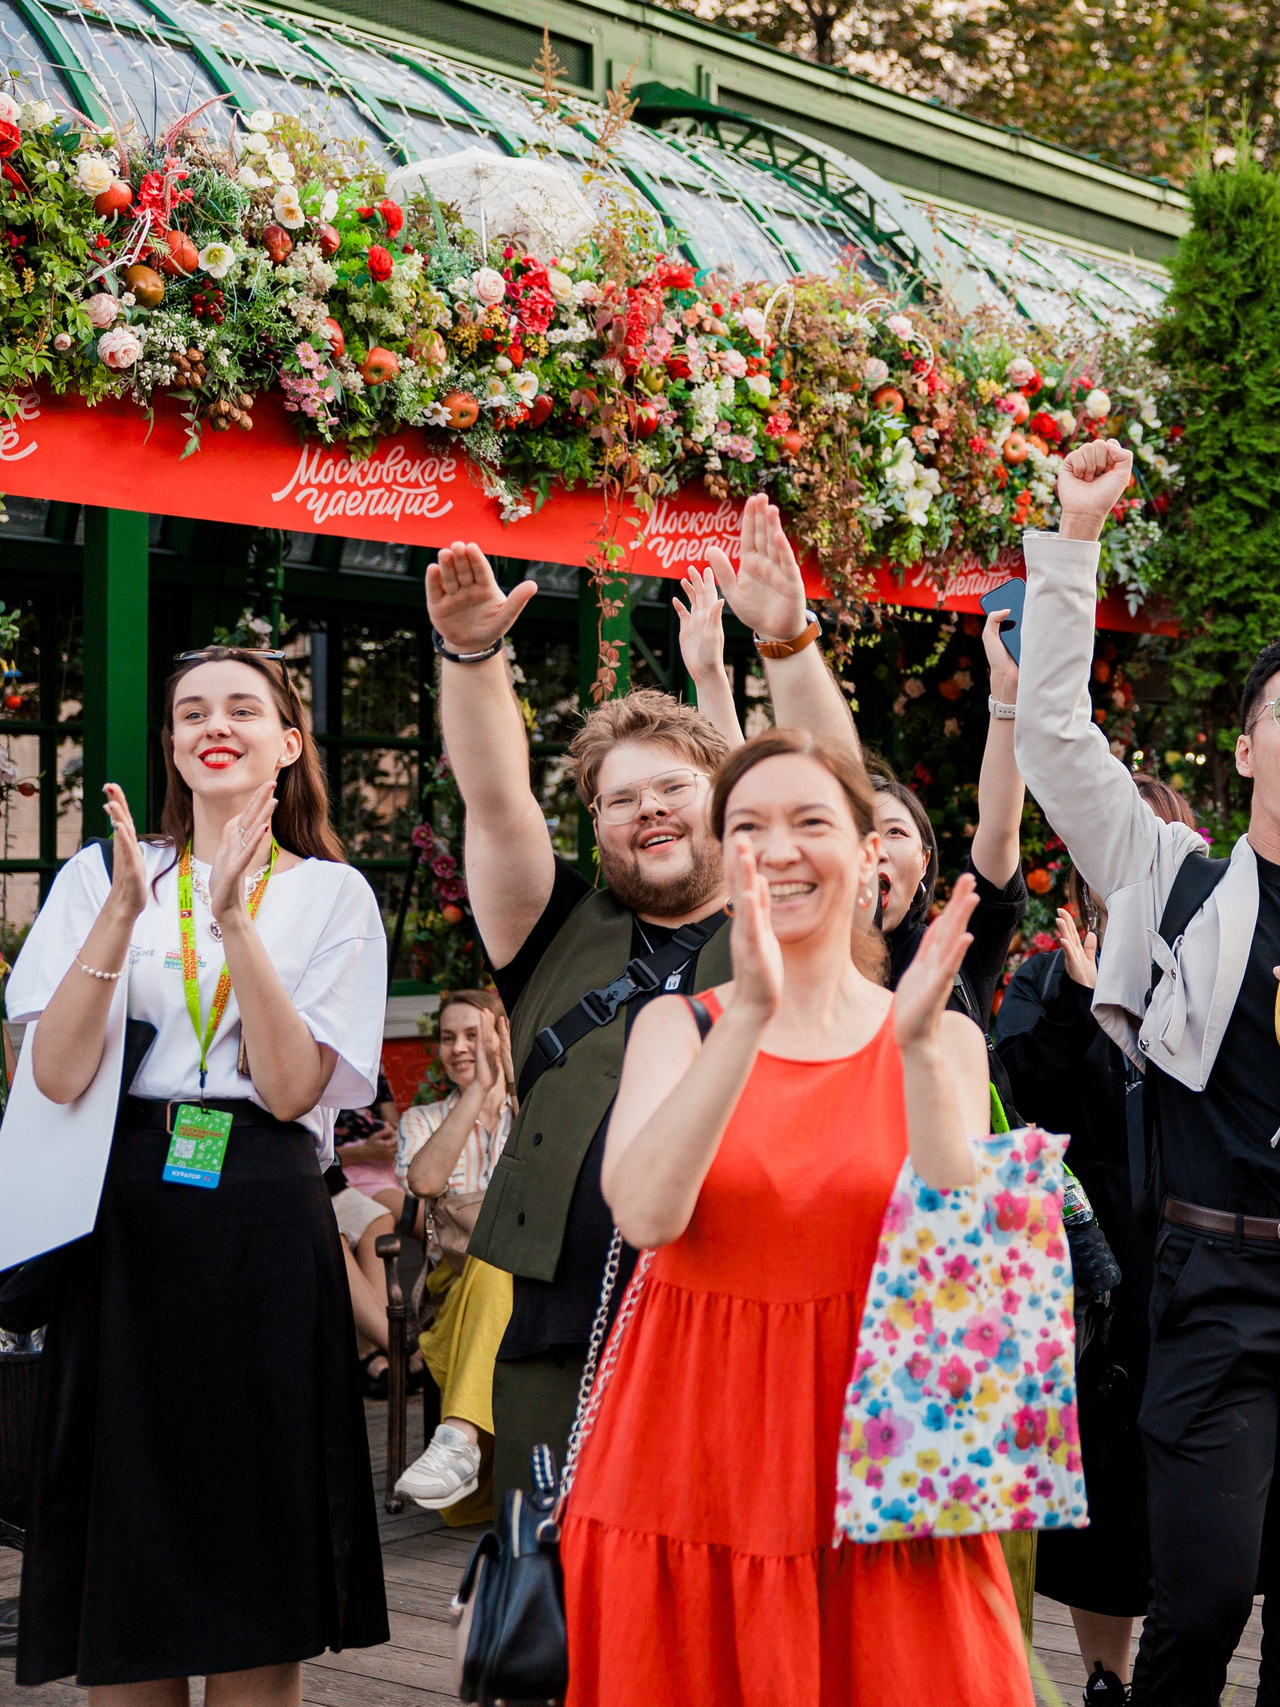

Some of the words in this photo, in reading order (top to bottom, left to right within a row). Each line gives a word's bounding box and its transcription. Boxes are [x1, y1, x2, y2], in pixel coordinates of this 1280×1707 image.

[271, 443, 457, 502] Московское
[629, 498, 745, 551] Московс
[181, 931, 191, 980] МОСКОВСКИЕ
[189, 949, 197, 979] СЕЗОНЫ
[213, 974, 226, 1008] СЕЗОНЫ
[171, 1170, 201, 1179] КУРАТОР
